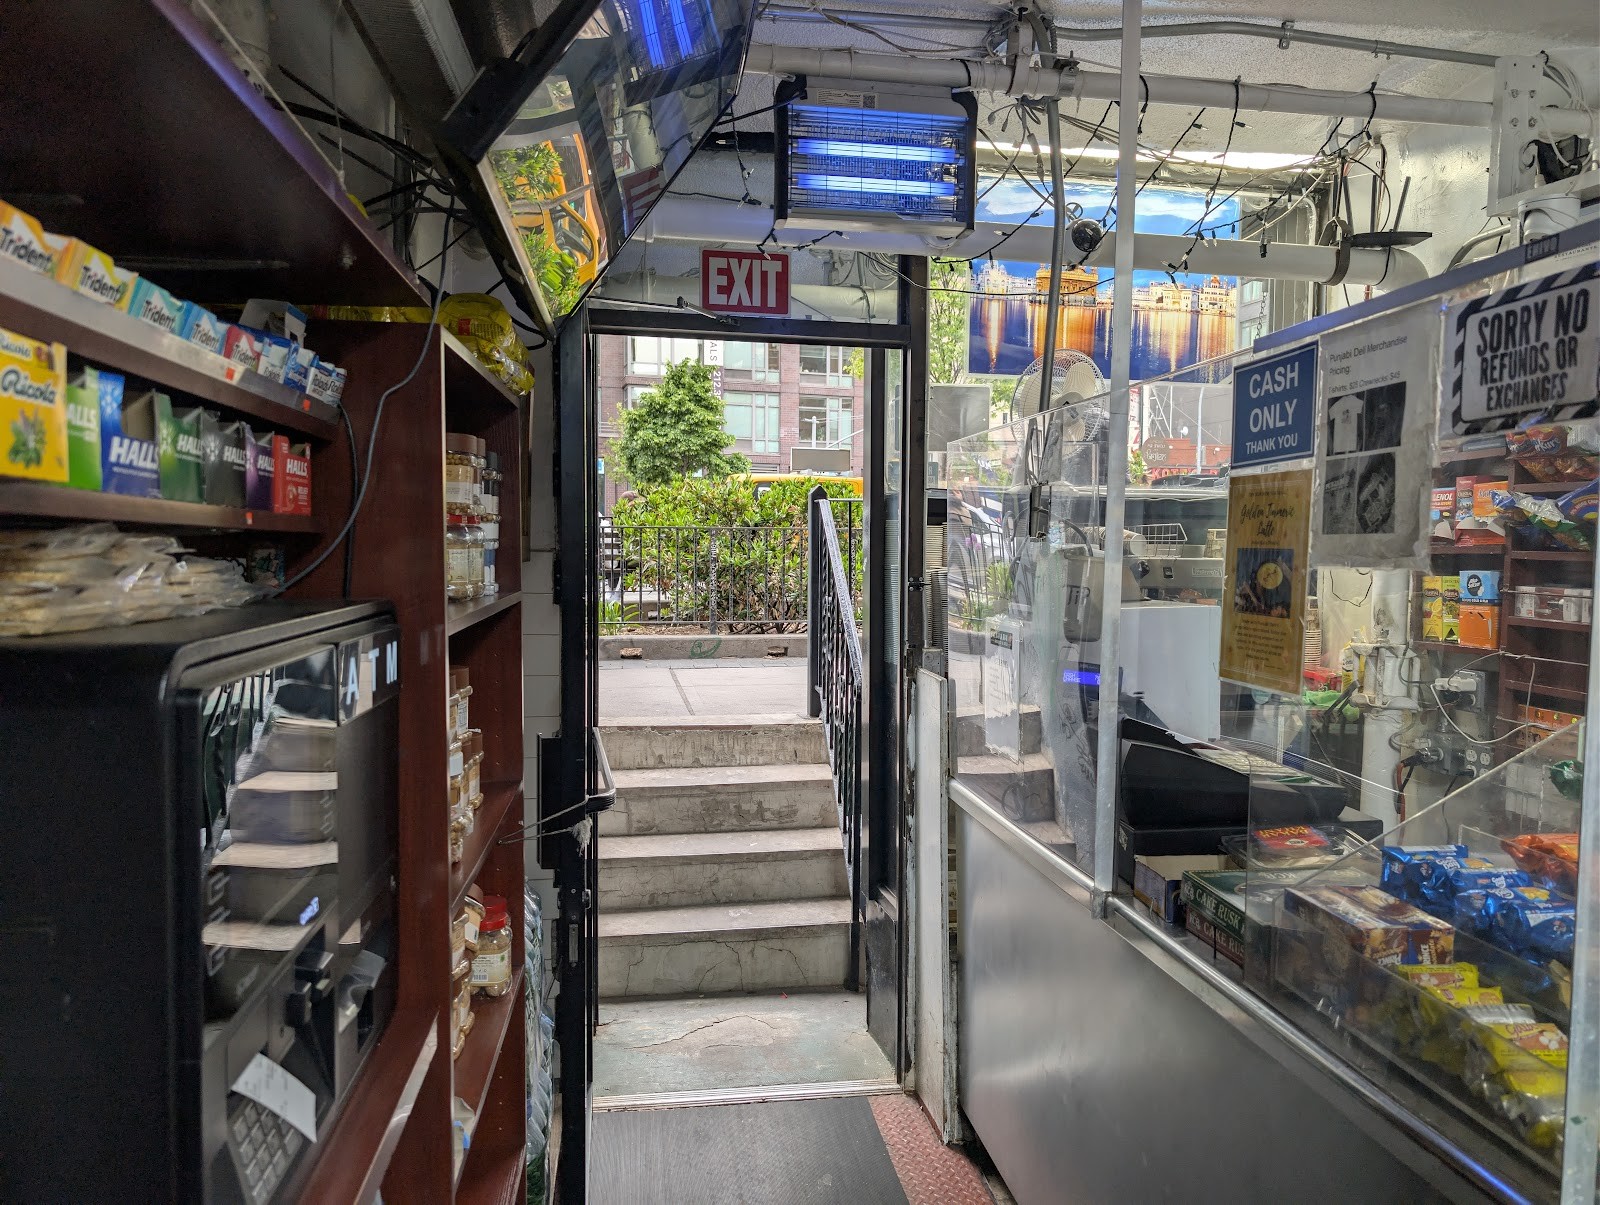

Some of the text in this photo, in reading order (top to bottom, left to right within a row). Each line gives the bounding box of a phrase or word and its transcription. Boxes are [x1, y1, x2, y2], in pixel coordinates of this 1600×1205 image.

[0, 227, 52, 273] Trident
[80, 265, 123, 301] Trident
[708, 256, 783, 308] EXIT
[142, 299, 177, 331] Trident
[1477, 288, 1590, 357] SORRY NO
[192, 323, 220, 350] Trident
[1329, 336, 1407, 362] Punjabi Deli Merchandise
[232, 343, 256, 367] Trident
[1480, 335, 1578, 386] REFUNDS OR
[1, 369, 56, 404] Ricola
[1249, 361, 1299, 399] CASH
[1486, 372, 1568, 412] EXCHANGES
[66, 403, 98, 430] ALLS
[1249, 399, 1297, 433] ONLY
[176, 433, 203, 456] HALL
[1245, 432, 1298, 455] THANK YOU
[286, 458, 308, 478] HALLS
[1240, 502, 1264, 524] Golden
[1257, 520, 1274, 537] Latte
[346, 640, 398, 705] ATM
[1196, 888, 1217, 912] CAKE
[1217, 904, 1240, 929] RUSK
[1203, 922, 1227, 946] CAKE
[1228, 937, 1245, 956] RUS
